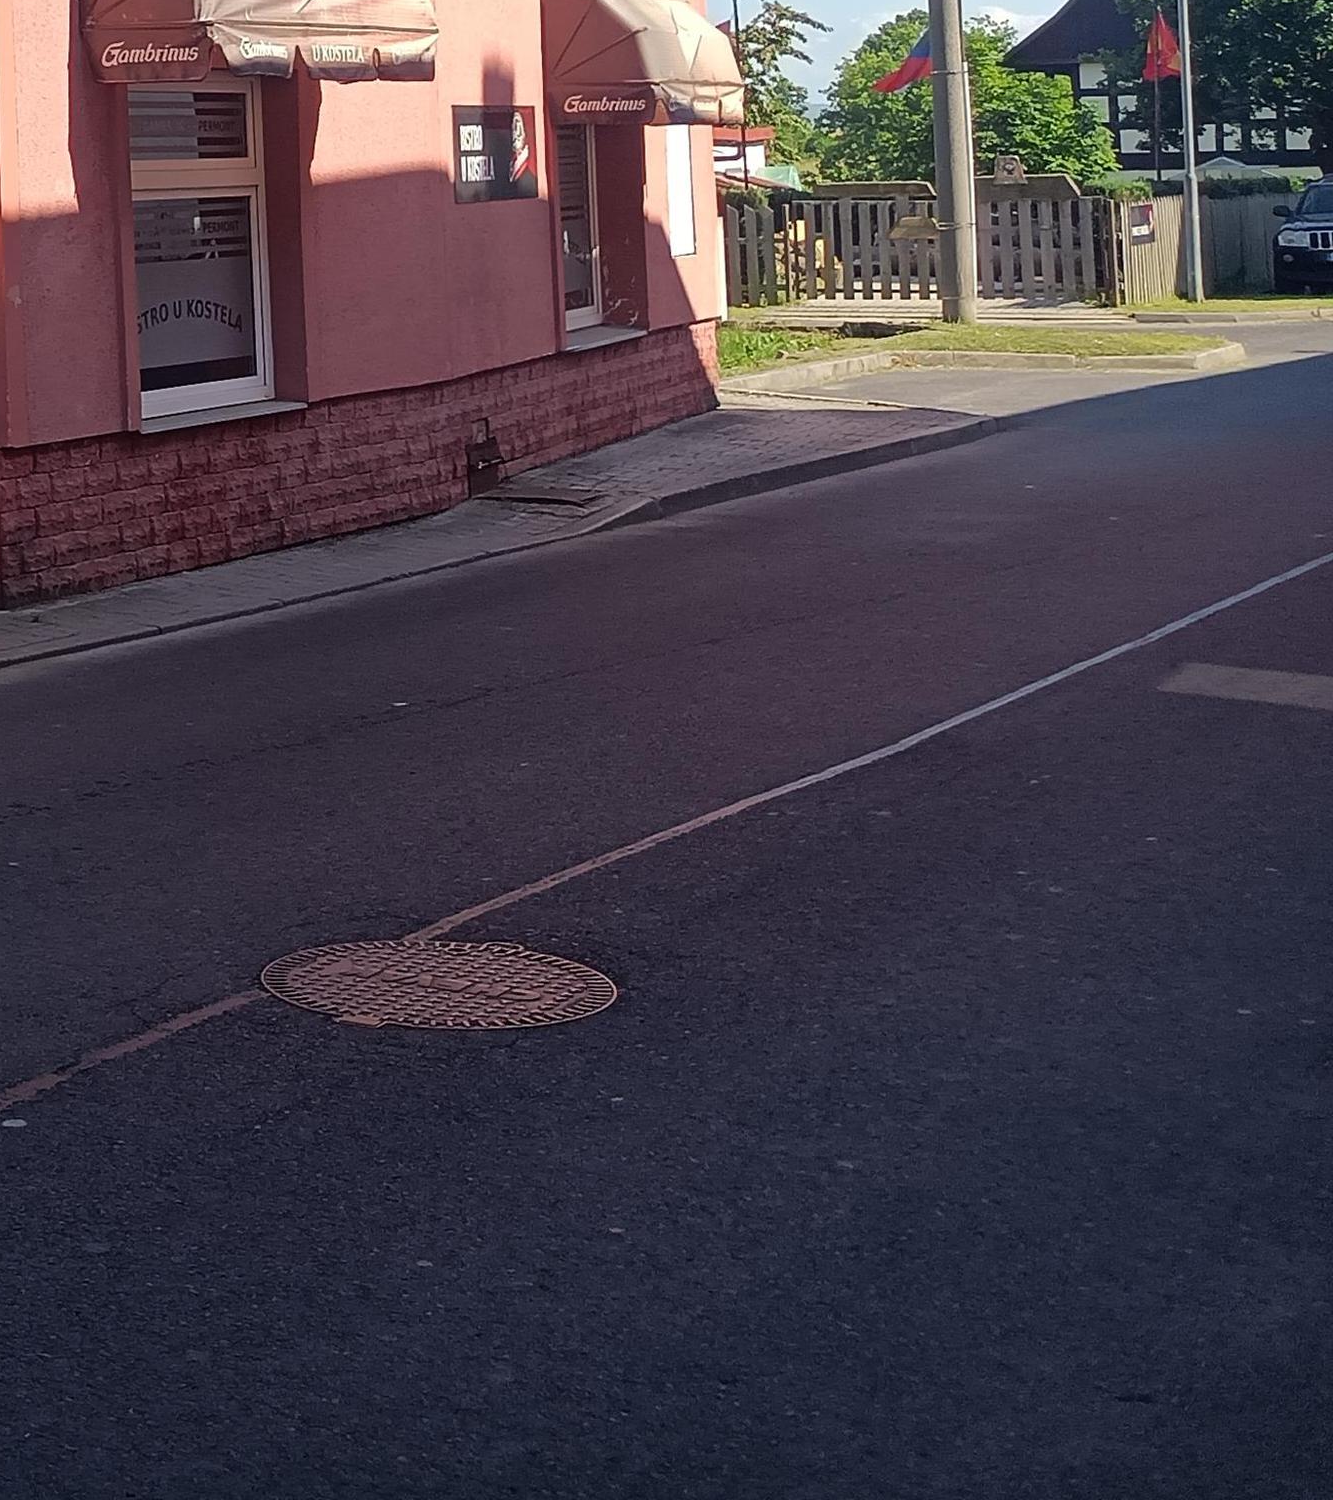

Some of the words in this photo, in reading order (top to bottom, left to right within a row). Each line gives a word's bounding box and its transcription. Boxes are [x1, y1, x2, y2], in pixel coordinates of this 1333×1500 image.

[102, 41, 200, 67] Gambrinus
[564, 94, 646, 113] Gambrinus
[173, 300, 181, 319] U
[187, 299, 242, 332] KOSTELA
